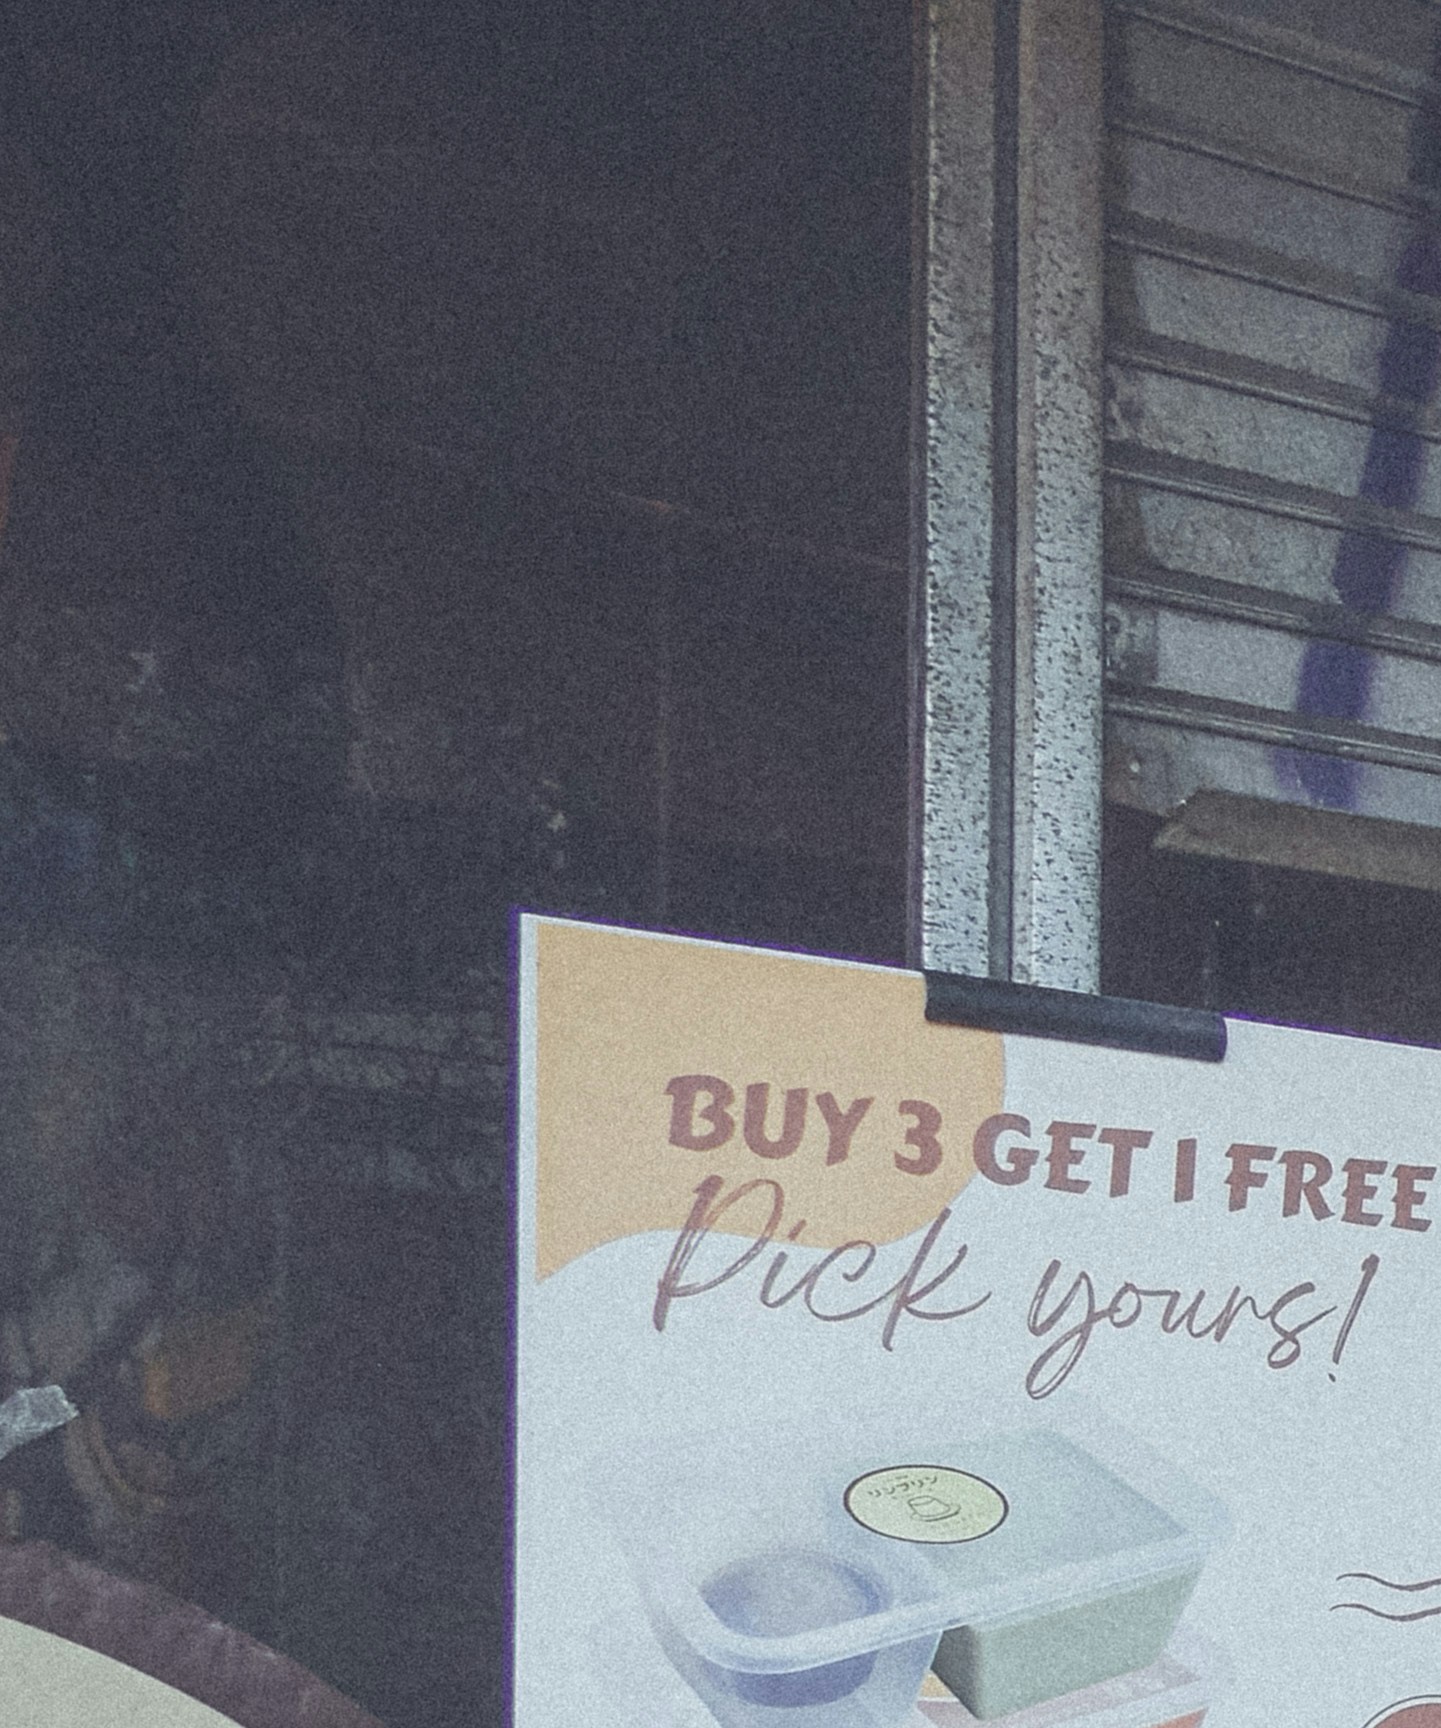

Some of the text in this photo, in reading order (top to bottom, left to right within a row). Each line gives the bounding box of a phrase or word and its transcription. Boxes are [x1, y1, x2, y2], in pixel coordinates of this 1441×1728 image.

[663, 1074, 874, 1164] BUY
[895, 1100, 943, 1174] 3
[972, 1113, 1151, 1196] GET
[1223, 1142, 1436, 1232] FREE
[653, 1173, 1381, 1399] Pick yours!
